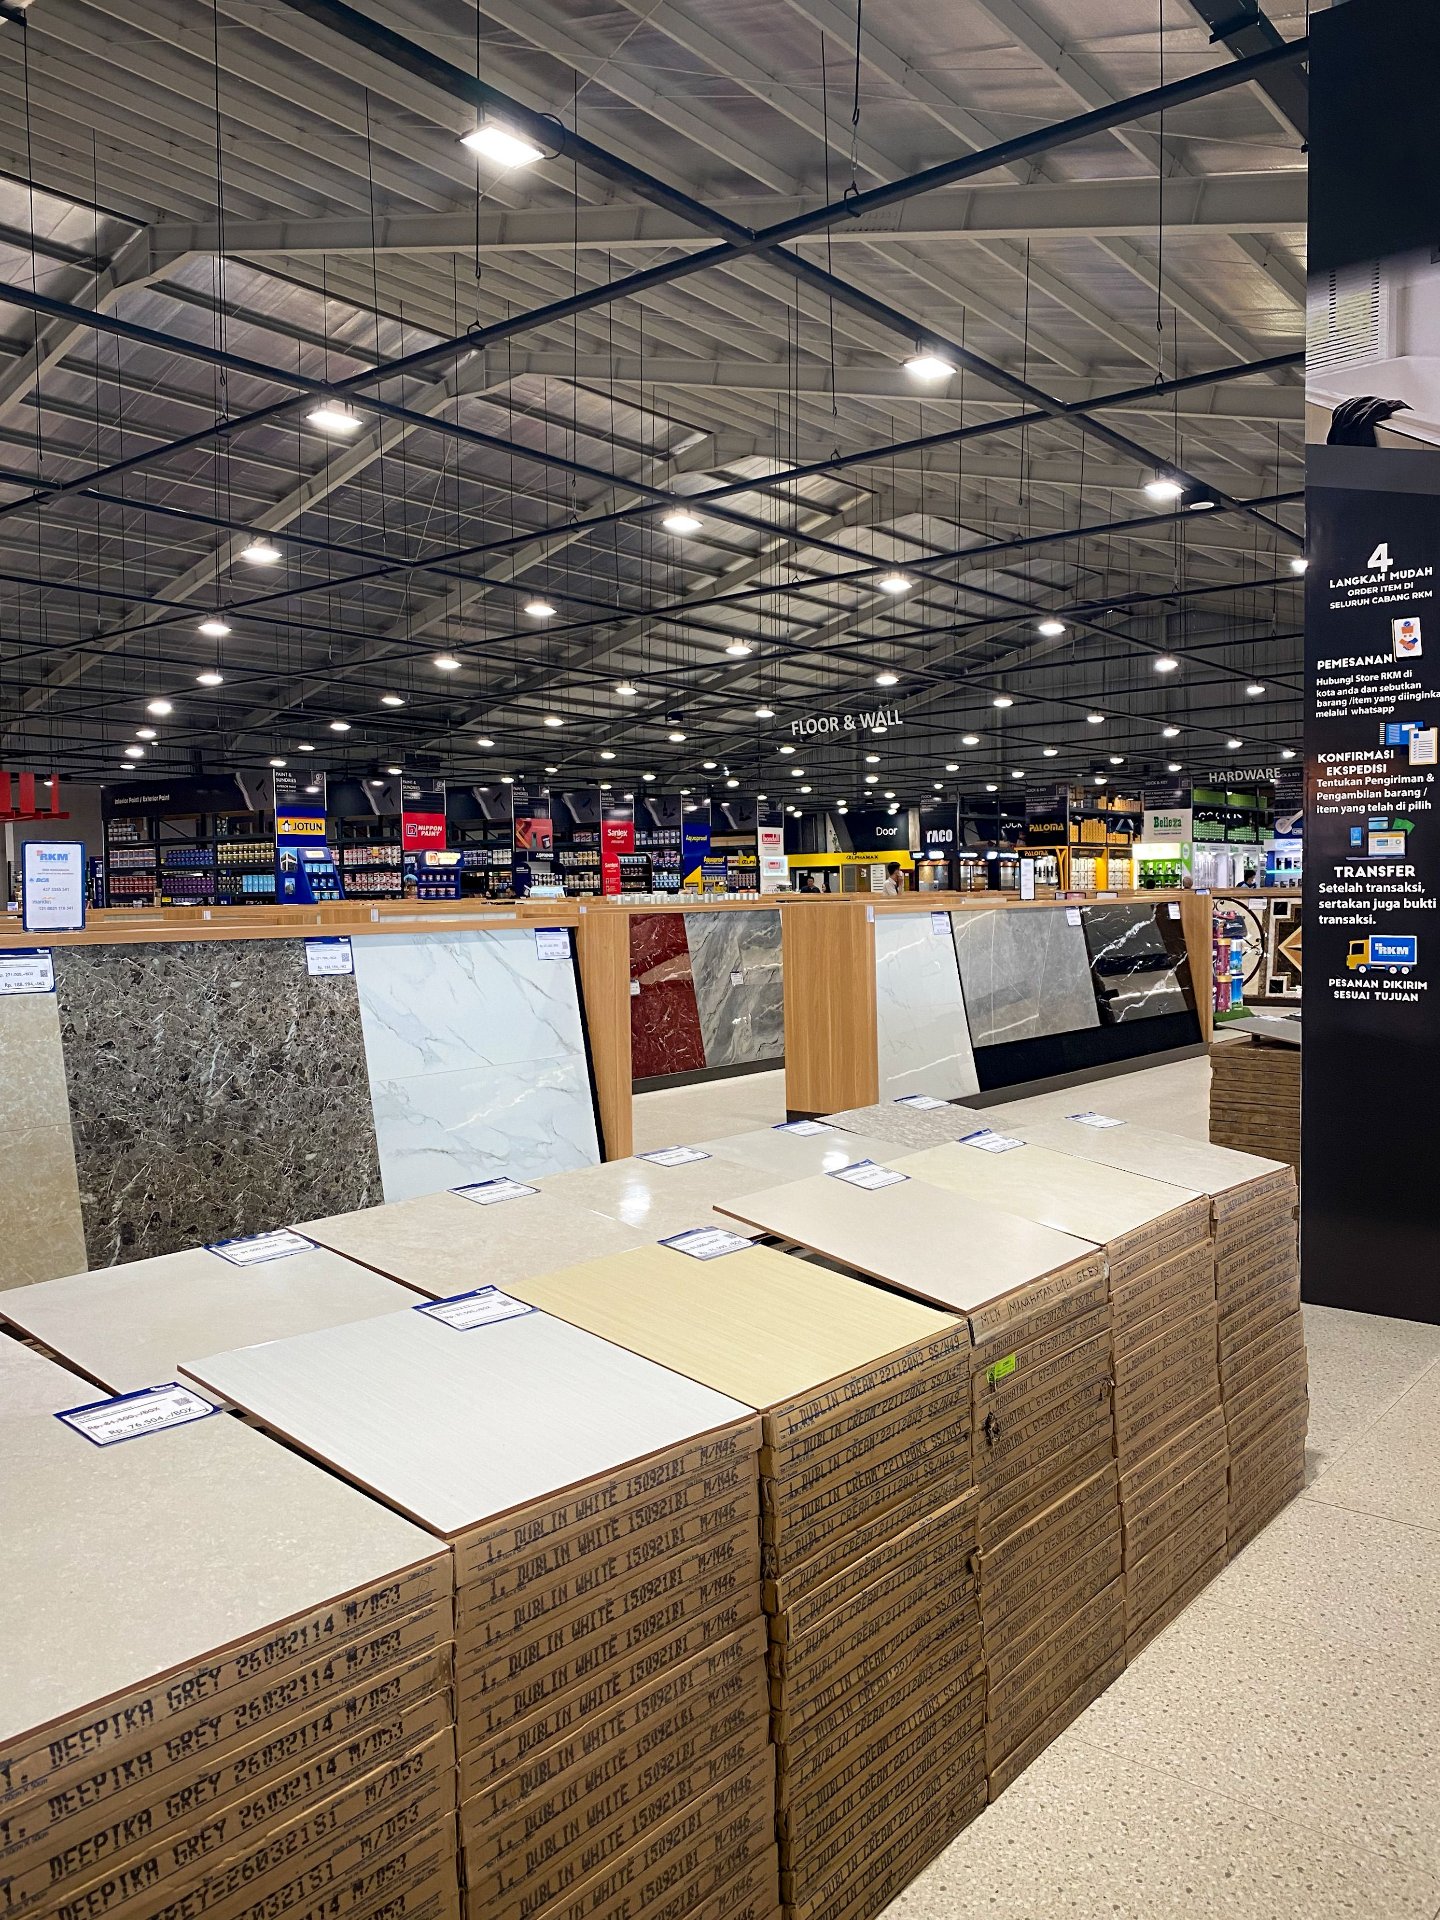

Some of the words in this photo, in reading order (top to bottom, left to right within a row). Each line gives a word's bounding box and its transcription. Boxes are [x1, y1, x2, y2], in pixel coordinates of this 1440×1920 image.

[1367, 542, 1393, 572] 4
[1330, 573, 1386, 589] LANGKAH
[1389, 567, 1433, 581] MUDAH
[1347, 587, 1378, 597] ORDER
[1380, 584, 1401, 593] ITEM
[1403, 581, 1414, 590] DI
[1329, 597, 1370, 610] SELURUH
[1371, 593, 1410, 604] CABANG
[1411, 590, 1433, 599] RKM
[1317, 653, 1393, 670] PEMESANAN
[1316, 674, 1354, 687] Hubungi
[1355, 673, 1379, 683] Store
[1380, 670, 1401, 680] RKM
[1403, 669, 1413, 679] di
[1316, 688, 1335, 698] kota
[1337, 686, 1359, 696] anda
[1361, 684, 1377, 694] dan
[1379, 681, 1422, 692] sebutkan
[1316, 698, 1347, 709] barang
[1373, 693, 1397, 705] yang
[1315, 708, 1348, 718] melalui
[1350, 705, 1395, 717] whatsapp
[791, 716, 839, 736] FLOOR
[843, 714, 856, 730] &
[858, 709, 904, 729] WALL
[1317, 749, 1395, 763] KONFIRMASI
[1208, 767, 1281, 783] HARDWARE
[1326, 764, 1387, 776] EKSPEDISI
[1316, 778, 1363, 788] Tentukan
[1364, 774, 1424, 787] Pengiriman
[1426, 773, 1435, 782] &
[1316, 789, 1382, 801] Pengambilan
[1384, 788, 1421, 799] barang
[1316, 804, 1339, 814] item
[1340, 804, 1366, 815] yang
[1367, 801, 1394, 812] telah
[1395, 801, 1406, 811] di
[1407, 800, 1432, 812] pilih
[293, 822, 323, 831] JOTUN
[876, 826, 898, 836] Door
[1029, 823, 1065, 832] PALOMA
[40, 852, 69, 861] RKM
[1333, 864, 1416, 878] TRANSFER
[1318, 882, 1363, 893] Setelah
[1365, 881, 1426, 894] transaksi,
[1318, 899, 1371, 909] sertakan
[1372, 898, 1401, 911] juga
[1403, 898, 1437, 909] bukti
[1318, 913, 1377, 925] transaksi.
[1375, 943, 1409, 956] RKM
[1328, 978, 1379, 989] PESANAN
[1383, 980, 1428, 990] DIKIRIM
[1333, 990, 1370, 1000] SESUAI
[1374, 991, 1419, 1002] TUJUAN
[799, 1391, 840, 1426] DUBLIN
[803, 1423, 842, 1455] DUBLIN
[514, 1508, 567, 1551] DUBLIN
[575, 1484, 618, 1522] WHITE
[518, 1542, 570, 1589] DUBLIN
[578, 1519, 620, 1557] WHITE
[514, 1584, 568, 1630] DUBLIN
[575, 1558, 618, 1595] WHITE
[508, 1629, 563, 1677] DUBLIN
[571, 1602, 614, 1641] WHITE
[514, 1665, 568, 1714] DUBLIN
[575, 1635, 618, 1678] WHITE
[49, 1699, 154, 1769] DEEPIKA
[166, 1666, 222, 1711] GREY
[518, 1704, 571, 1757] DUBLIN
[579, 1673, 621, 1716] WHITE
[520, 1744, 574, 1797] DUBLIN
[582, 1711, 626, 1754] WHITE
[48, 1751, 153, 1823] DEEPIKA
[165, 1716, 222, 1762] GREY
[50, 1808, 153, 1882] DEEPIKA
[166, 1771, 222, 1819] GREY
[172, 1818, 227, 1867] GREY
